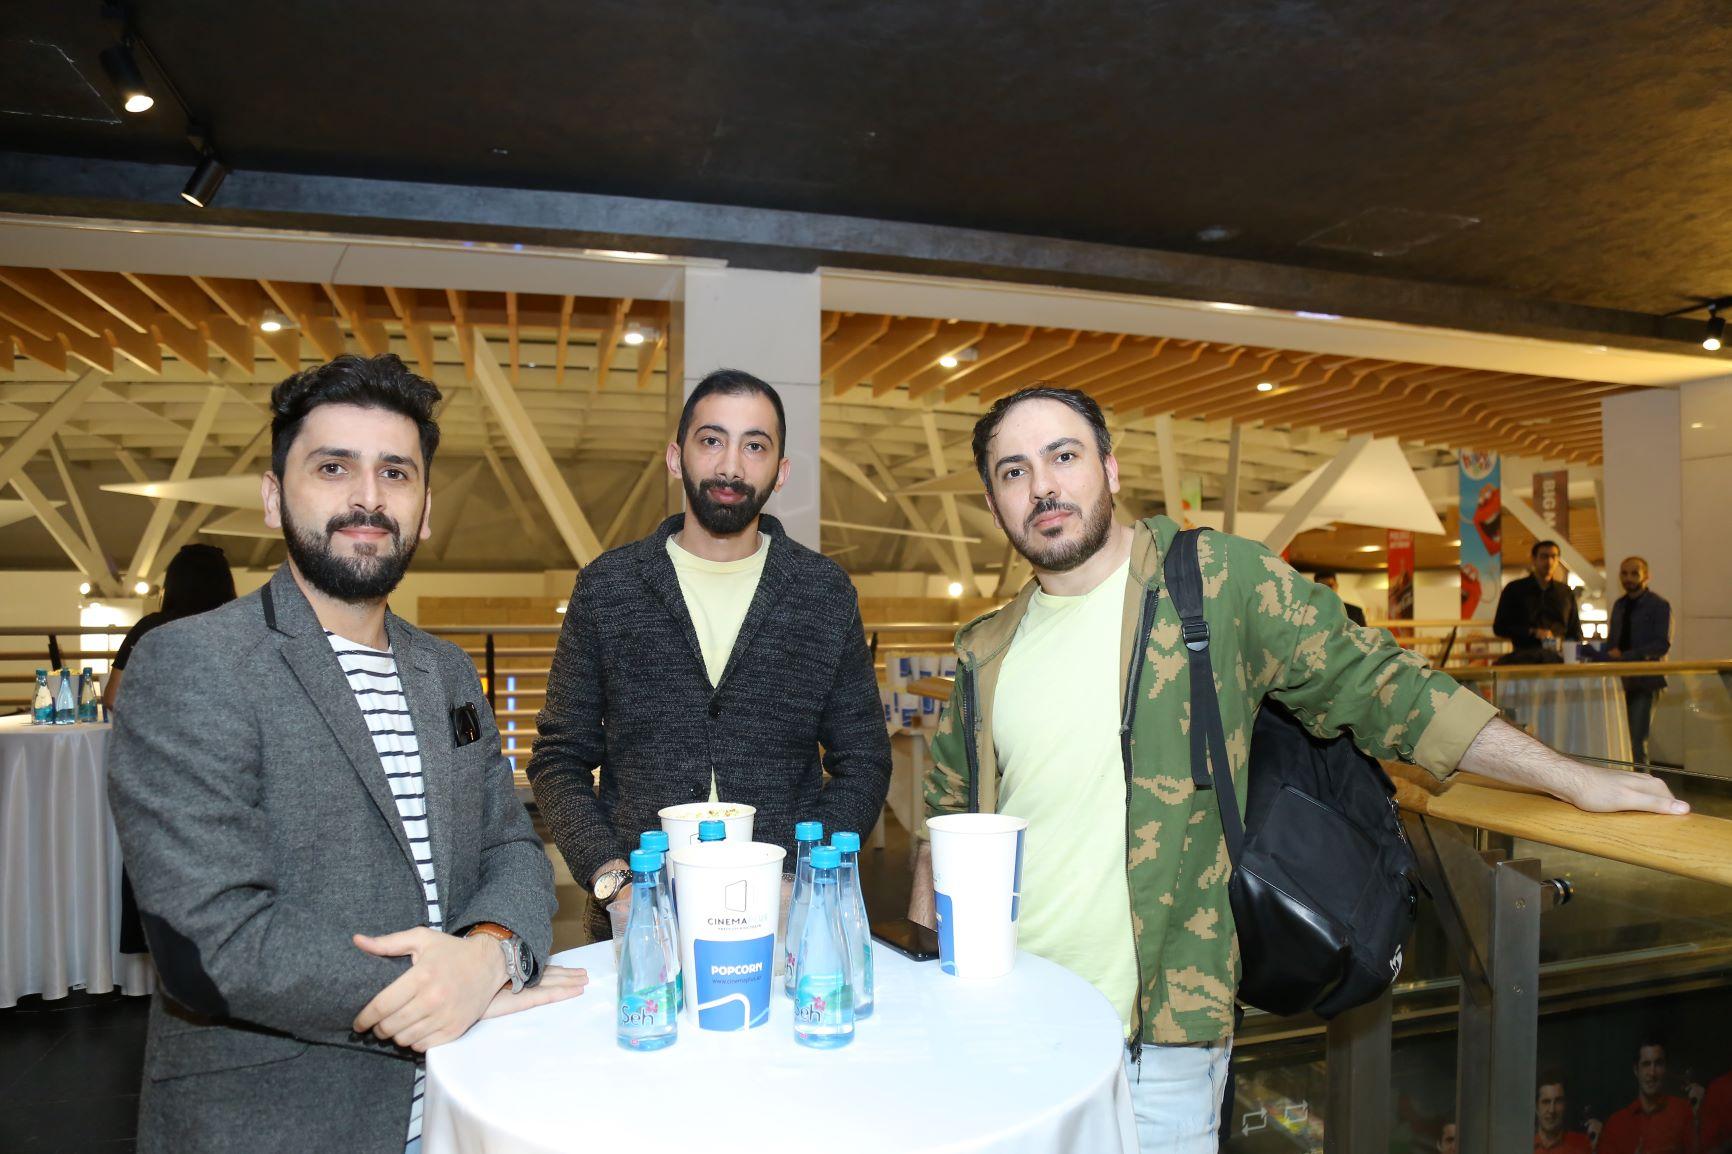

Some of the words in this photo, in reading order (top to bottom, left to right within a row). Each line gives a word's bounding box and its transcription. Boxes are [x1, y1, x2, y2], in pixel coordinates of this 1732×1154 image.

[707, 917, 748, 926] CINEMA
[711, 962, 763, 976] POPCORN
[621, 1005, 654, 1026] Seh
[795, 998, 821, 1022] Seh
